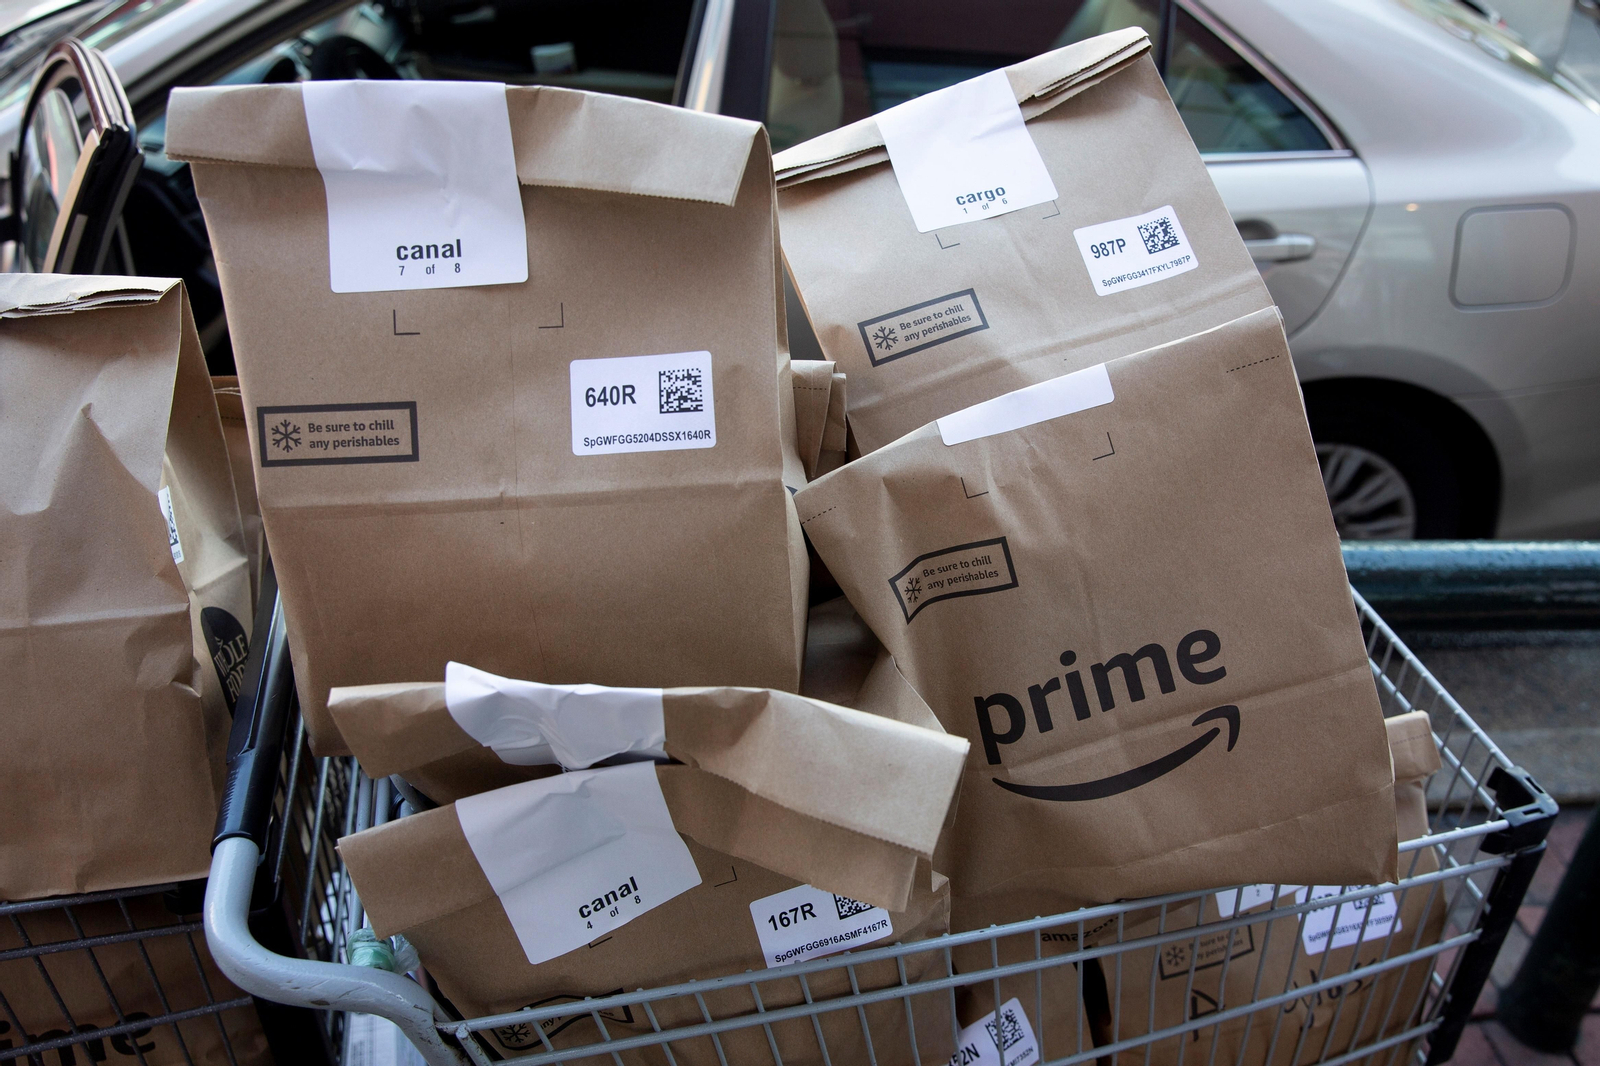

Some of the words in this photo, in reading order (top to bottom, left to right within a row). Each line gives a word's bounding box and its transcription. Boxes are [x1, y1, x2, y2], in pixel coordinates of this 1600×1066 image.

[956, 187, 1006, 205] cargo
[981, 202, 990, 210] of
[396, 239, 462, 261] canal
[1090, 238, 1126, 259] 987P
[399, 265, 405, 276] 7
[425, 264, 435, 275] of
[454, 262, 461, 273] 8
[899, 322, 912, 331] Be
[912, 315, 932, 327] sure
[932, 311, 943, 320] to
[944, 304, 965, 316] chill
[904, 331, 920, 342] any
[921, 315, 972, 337] perishables
[585, 384, 637, 408] 640R
[308, 423, 322, 433] Be
[325, 423, 350, 433] sure
[353, 421, 366, 431] to
[369, 419, 394, 431] chill
[309, 439, 329, 451] any
[333, 435, 400, 450] perishables
[583, 429, 712, 449] SpGWFGG5204DSSX1640R
[922, 568, 936, 578] Be
[937, 562, 958, 574] sure
[959, 559, 970, 569] to
[971, 555, 992, 567] chill
[927, 579, 944, 591] any
[946, 569, 999, 586] perishables
[974, 629, 1227, 765] prime
[579, 876, 639, 919] canal
[586, 921, 593, 929] 4
[609, 906, 619, 918] of
[634, 895, 642, 904] 8
[768, 902, 817, 931] 167R
